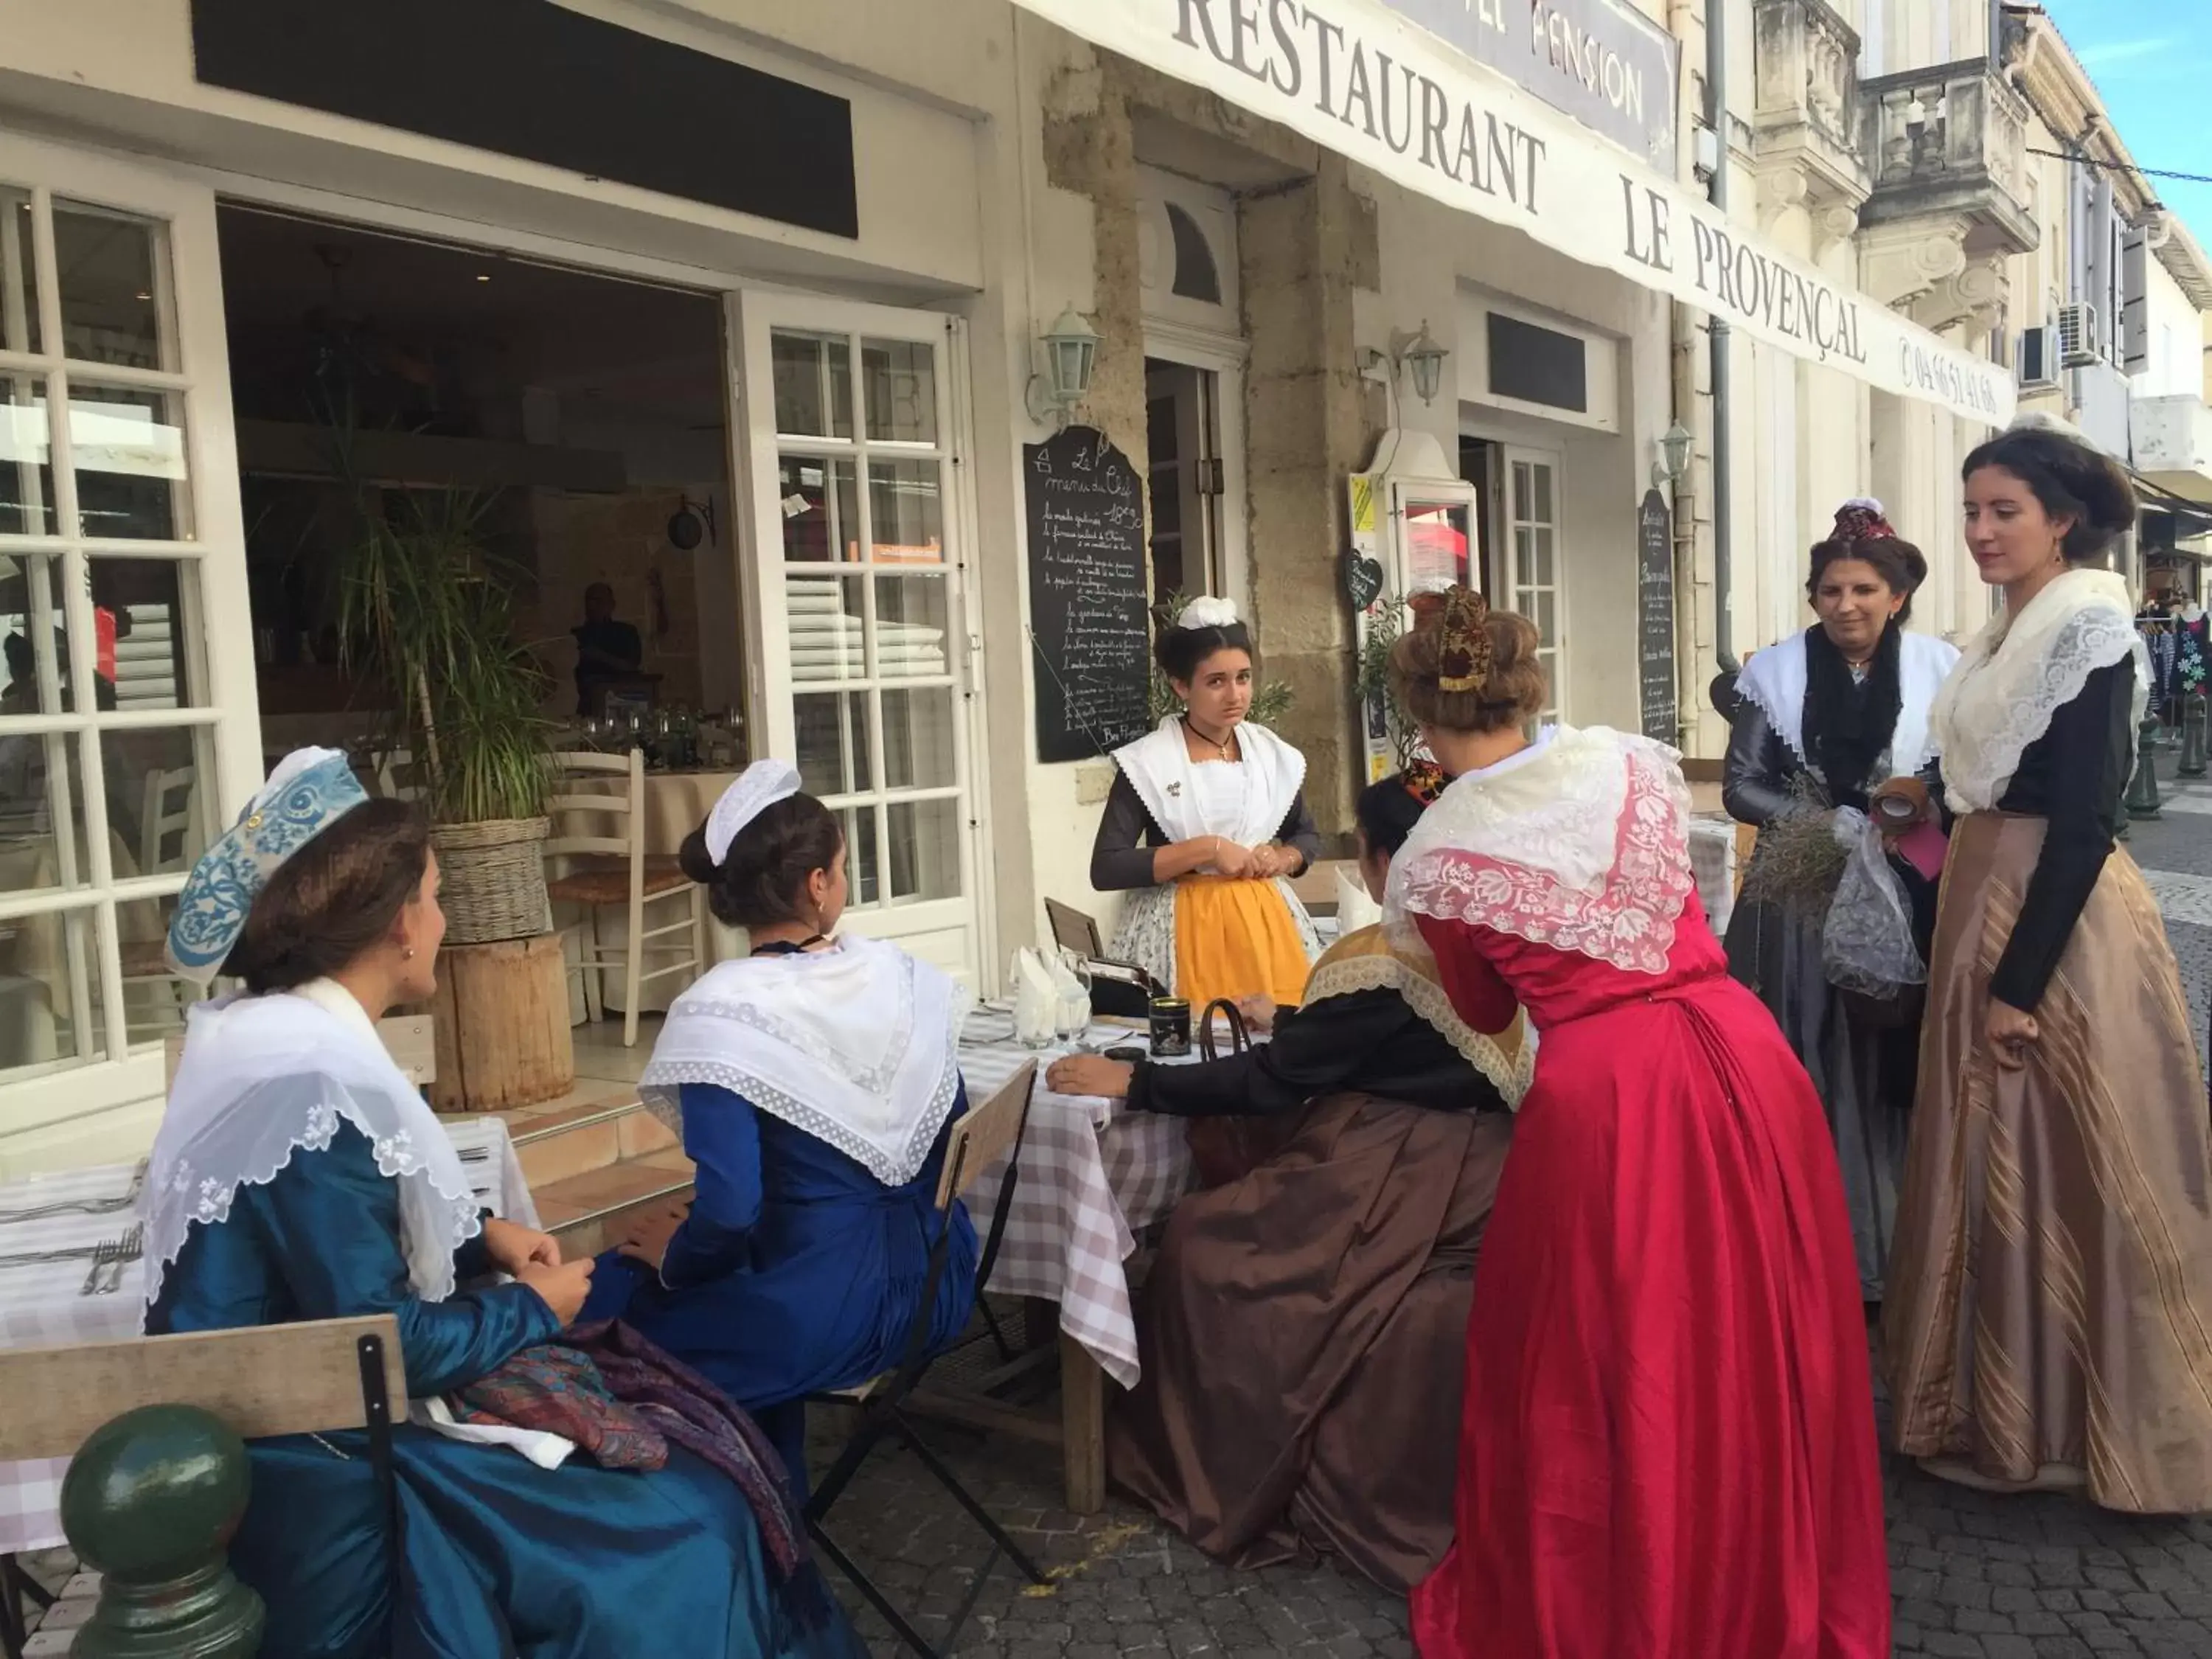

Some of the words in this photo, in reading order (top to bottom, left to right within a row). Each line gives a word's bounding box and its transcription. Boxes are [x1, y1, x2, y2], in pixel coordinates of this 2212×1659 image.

[1531, 0, 1643, 125] PENSION
[1619, 174, 1673, 274] LE
[1691, 215, 1866, 364] PROVENÇAL
